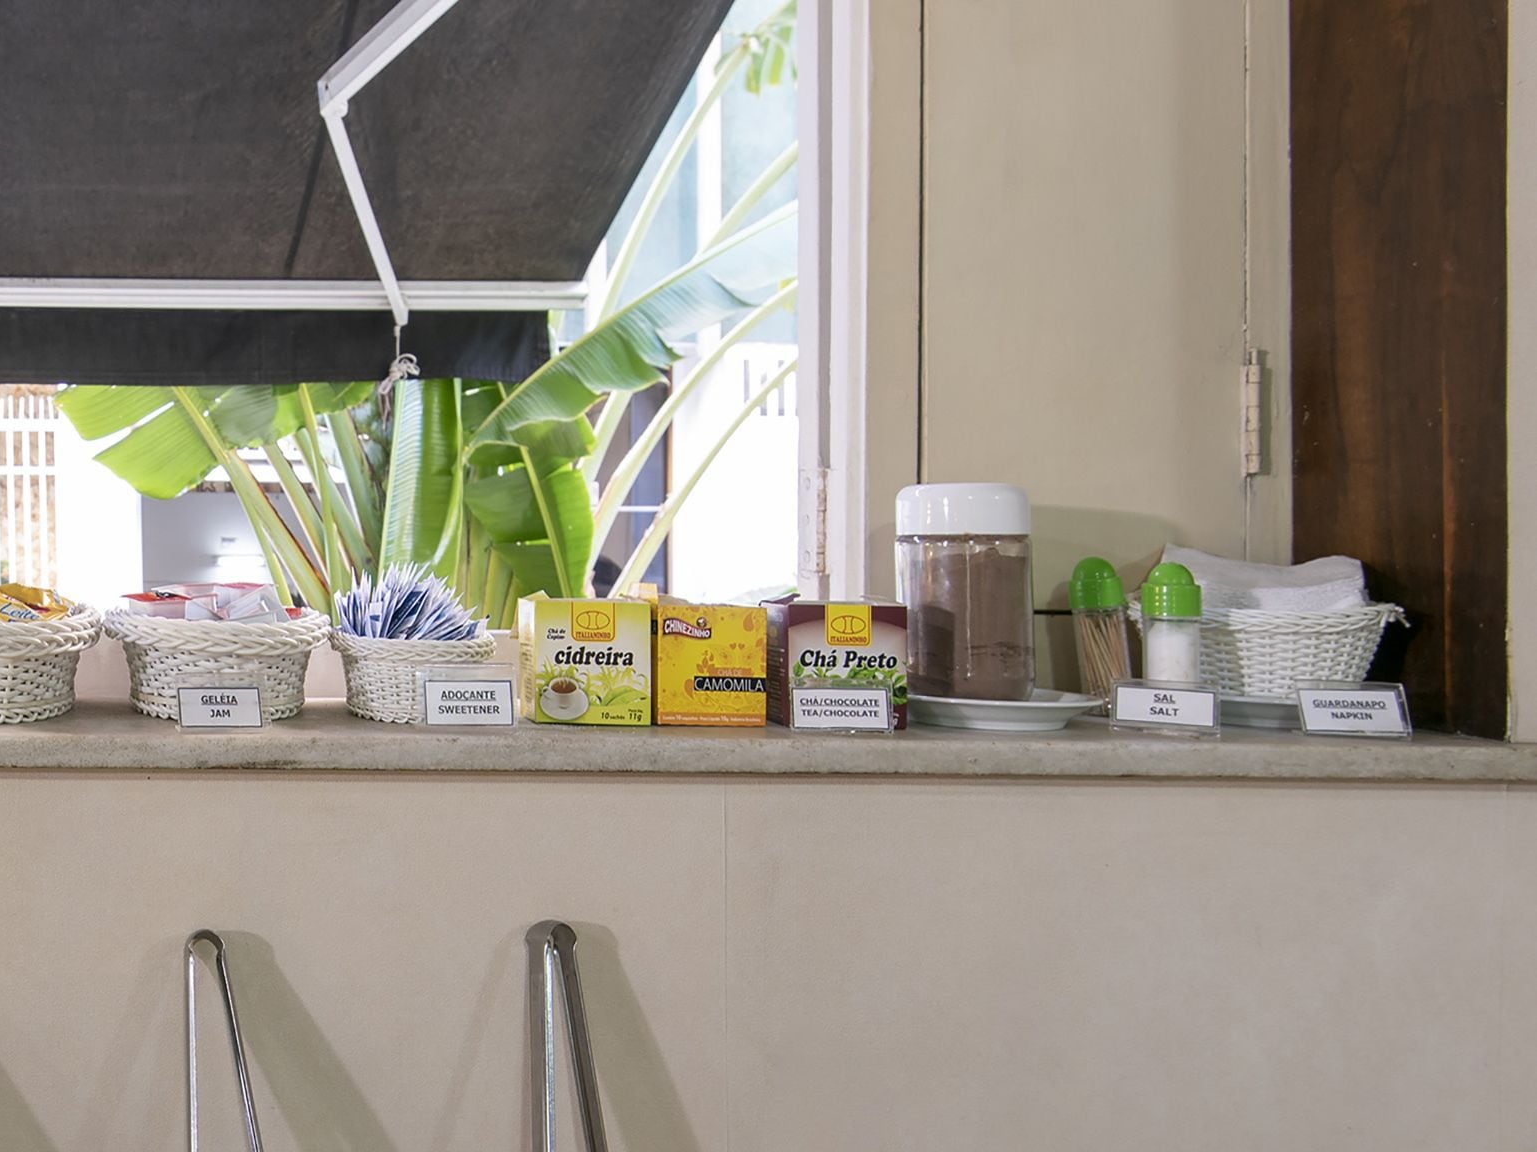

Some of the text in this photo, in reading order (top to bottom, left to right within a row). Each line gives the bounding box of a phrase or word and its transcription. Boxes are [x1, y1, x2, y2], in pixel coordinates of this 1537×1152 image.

[554, 646, 634, 666] cidreira
[799, 649, 898, 668] Chá Preto
[694, 678, 764, 691] CAMOMILA
[201, 693, 238, 705] GELÉIA
[441, 690, 496, 701] ADOÇANTE
[1153, 692, 1176, 704] SAL
[438, 705, 500, 714] SWEETENER
[1312, 699, 1387, 710] GUARDANAPO
[210, 709, 231, 718] JAM
[801, 709, 879, 718] TEA/CHOCOLATE
[1149, 706, 1179, 717] SALT
[1331, 711, 1373, 721] NAPKIN
